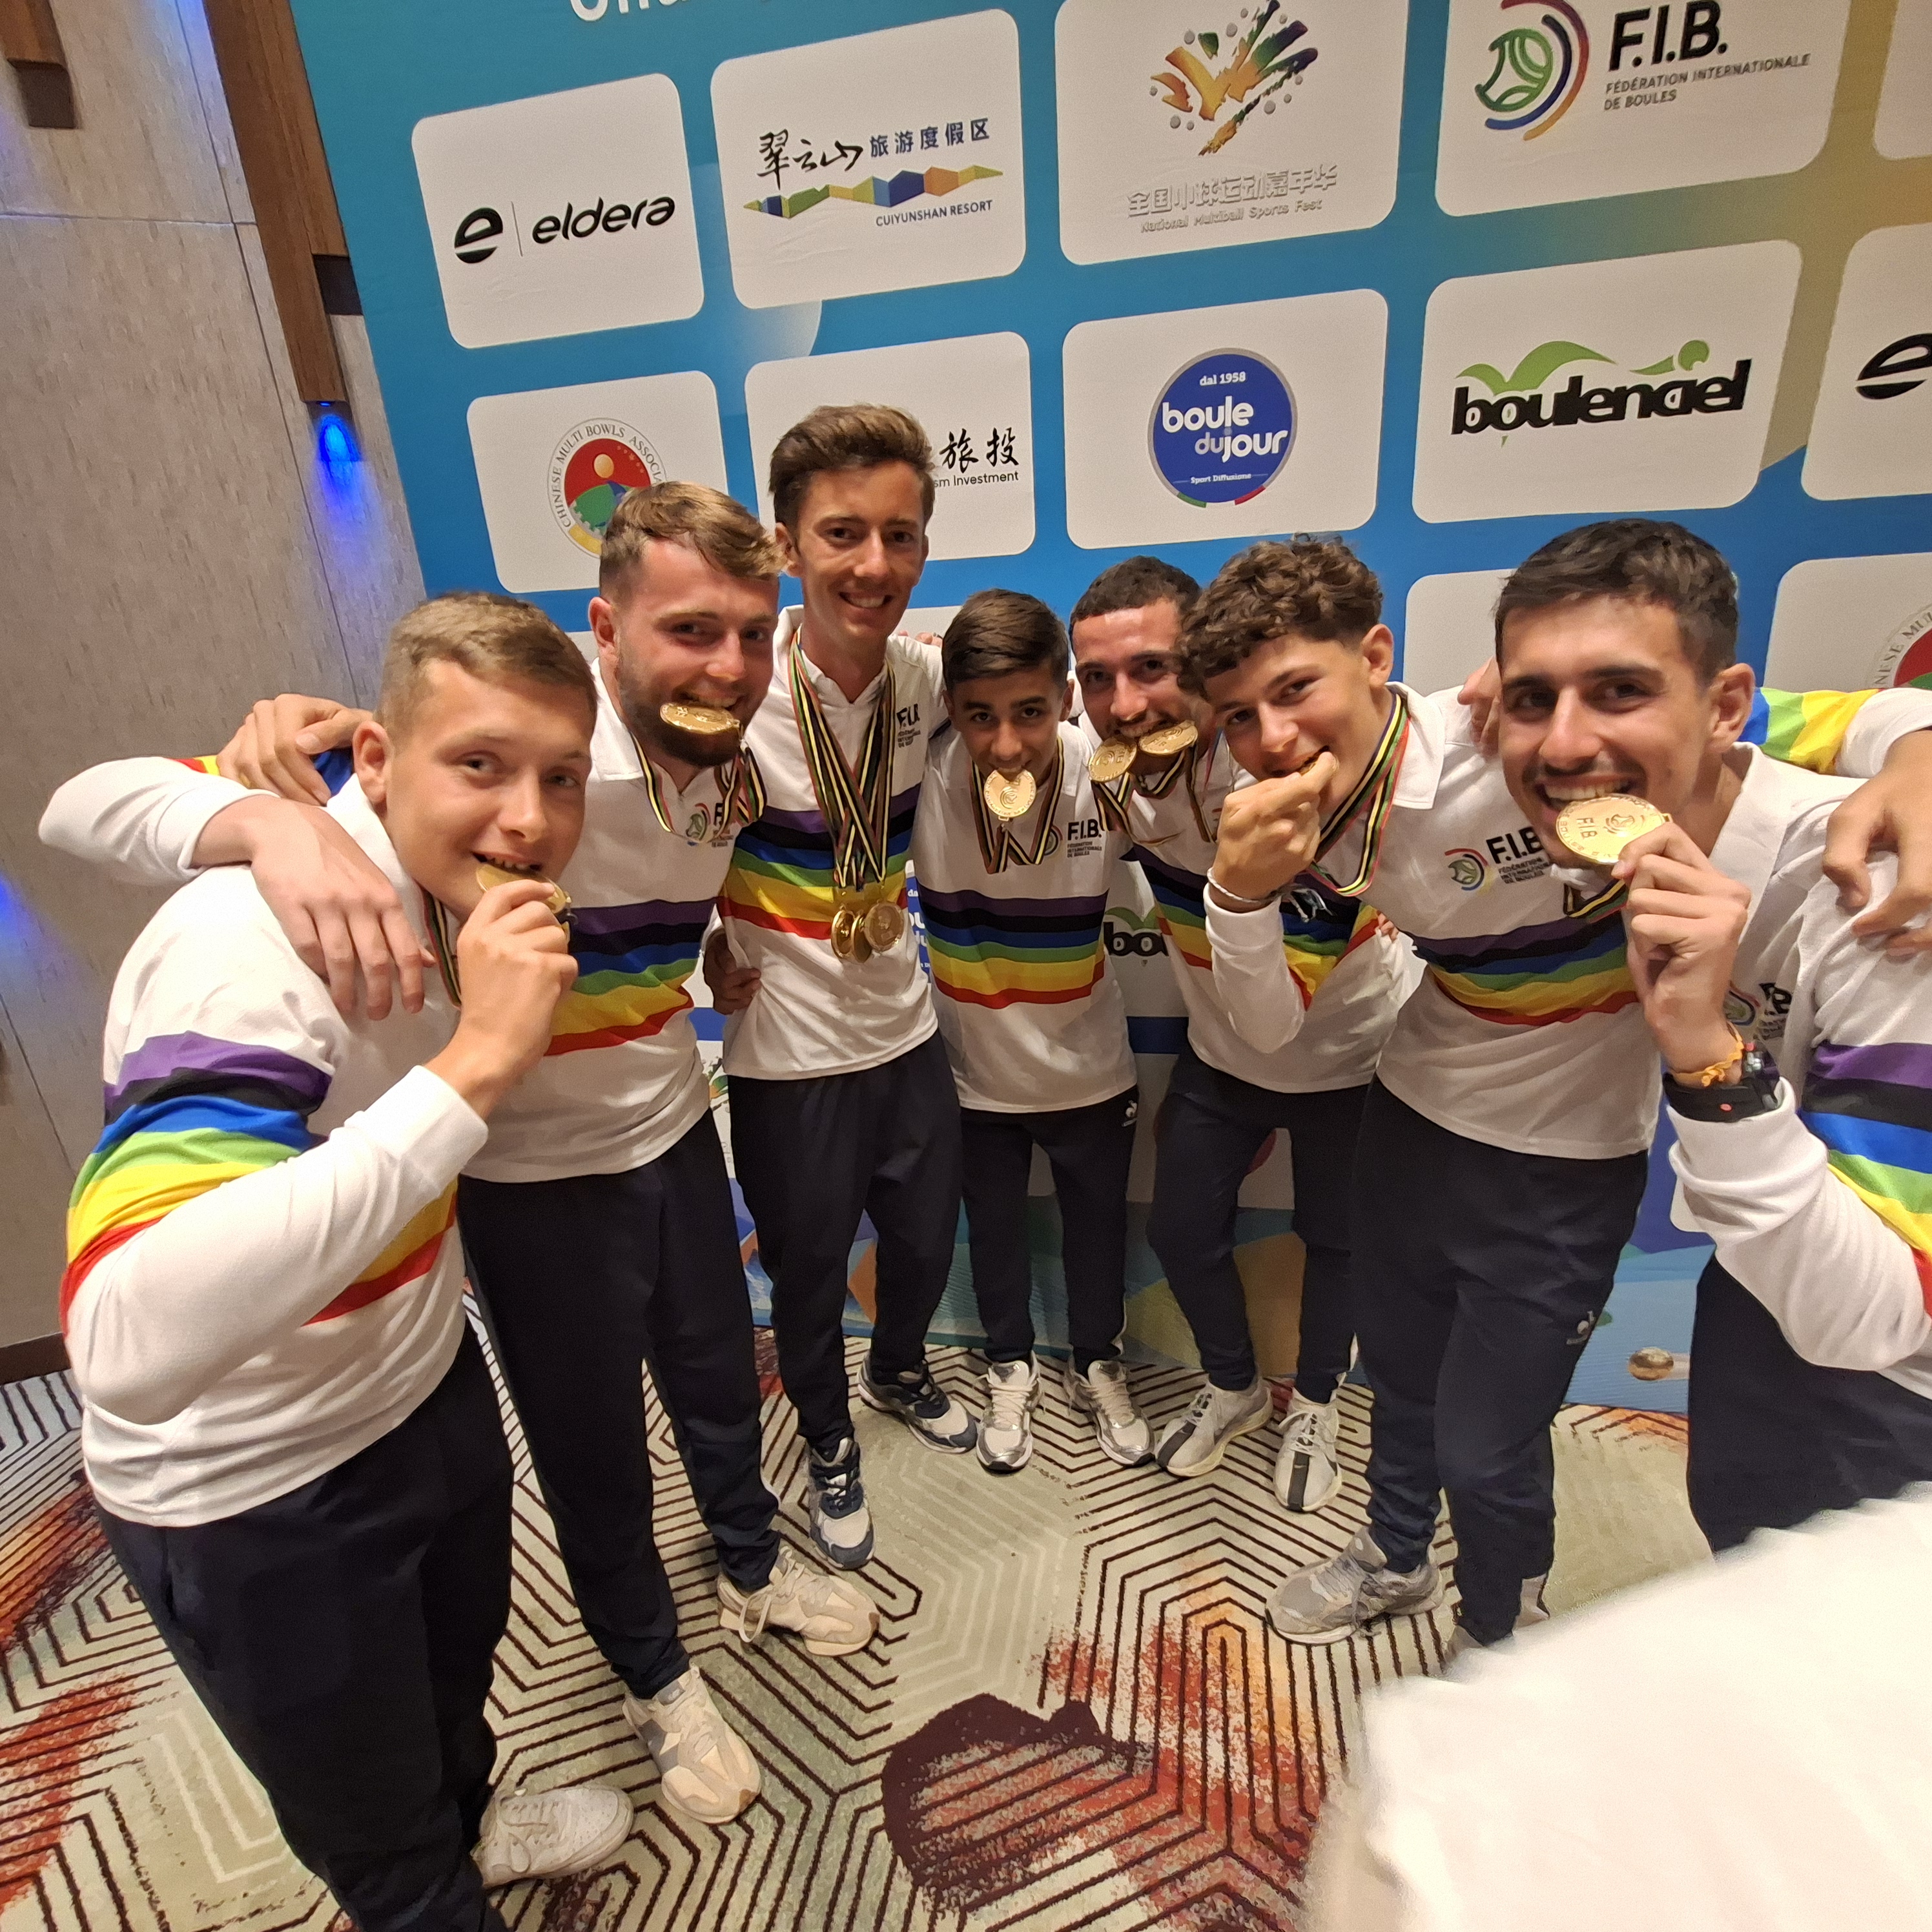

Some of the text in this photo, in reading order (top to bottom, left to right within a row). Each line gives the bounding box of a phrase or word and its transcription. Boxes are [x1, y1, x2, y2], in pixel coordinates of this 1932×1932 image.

[1608, 0, 1727, 72] F.I.B.
[1605, 53, 1811, 94] FÉDÉRATION INTERNATIONALE
[1603, 89, 1678, 111] DE BOULES
[870, 117, 990, 158] 旅游度假区
[532, 196, 675, 245] eldera
[876, 200, 993, 227] CUIYUNSHAN RESORT
[1140, 198, 1323, 233] National Multiball Sports Fest
[1199, 371, 1246, 386] dal 1958
[585, 424, 626, 438] BOWLS
[1162, 395, 1254, 433] boule
[556, 430, 584, 464] MULTI
[953, 471, 1019, 486] Investment
[1190, 473, 1252, 485] Sport Diffusione
[551, 466, 572, 528] CHINESE
[1067, 818, 1102, 841] F.I.B.
